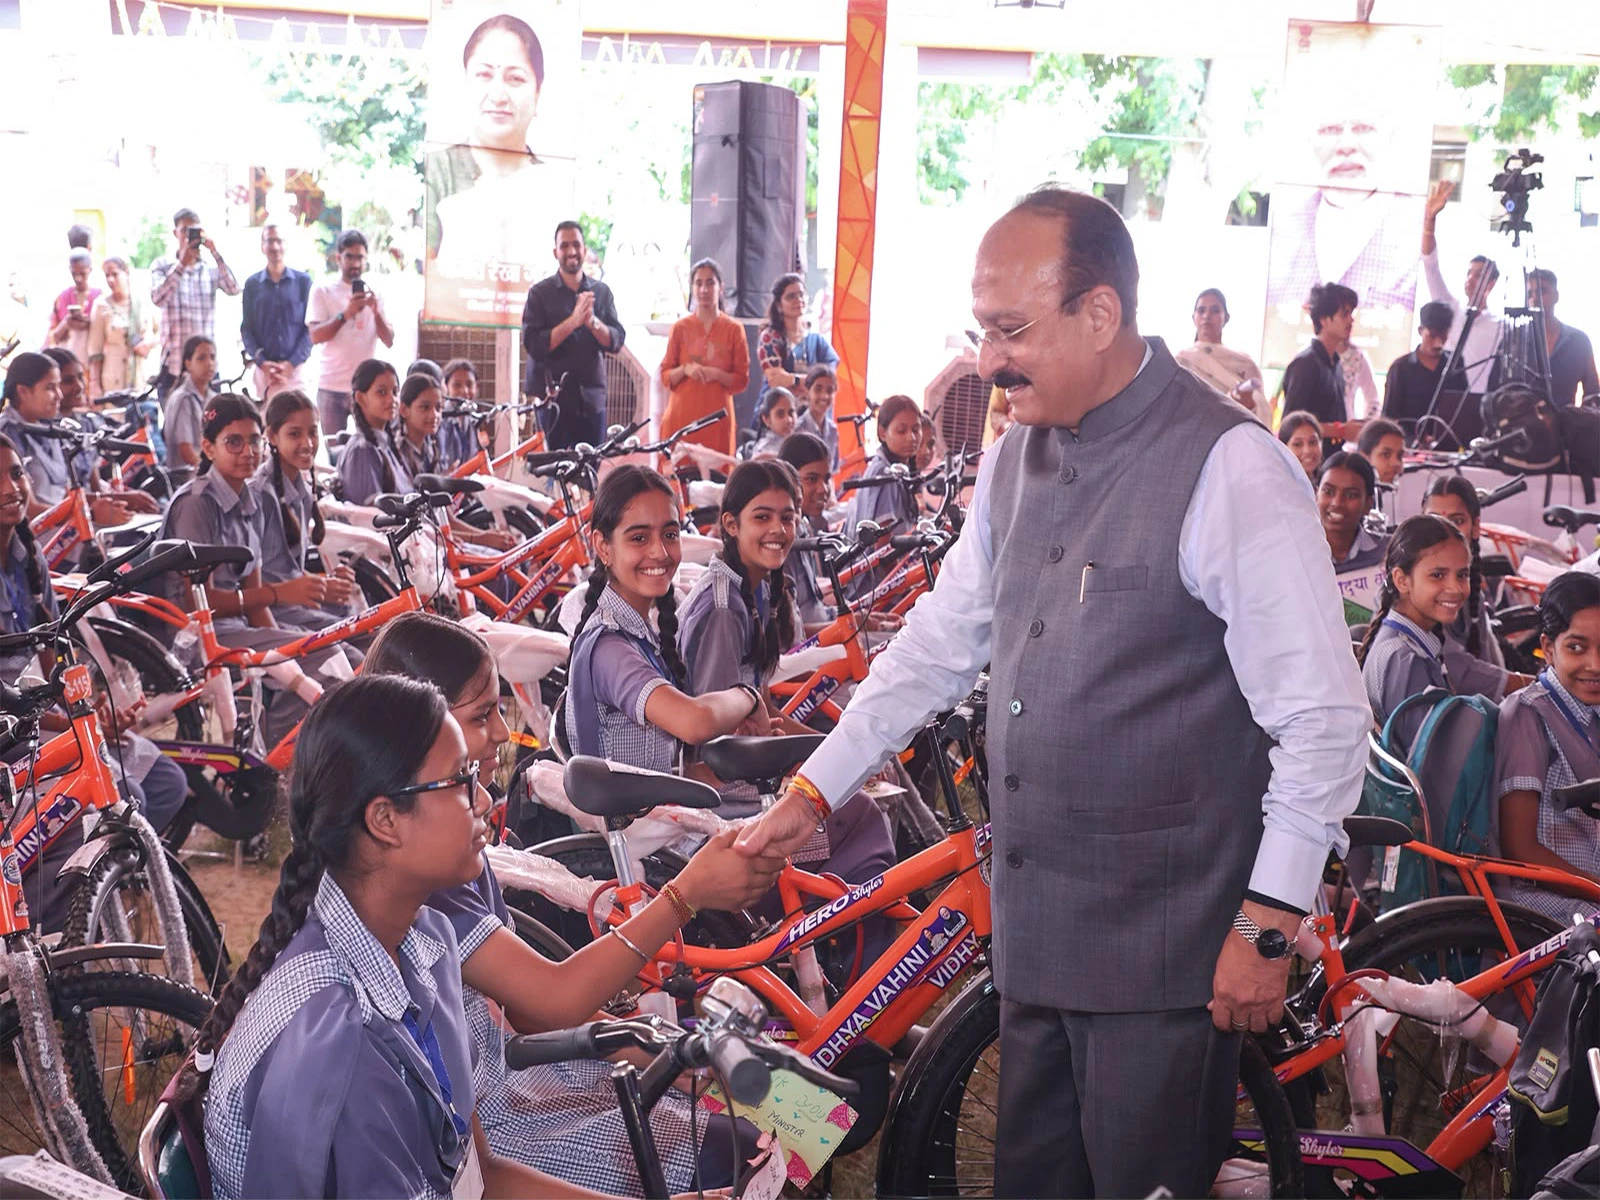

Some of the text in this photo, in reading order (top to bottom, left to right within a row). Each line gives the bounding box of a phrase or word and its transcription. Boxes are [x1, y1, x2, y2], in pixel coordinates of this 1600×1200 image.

[515, 579, 546, 611] VAHINI
[789, 894, 849, 943] HERO
[1529, 926, 1577, 962] HER
[866, 943, 930, 1014] VAHINI
